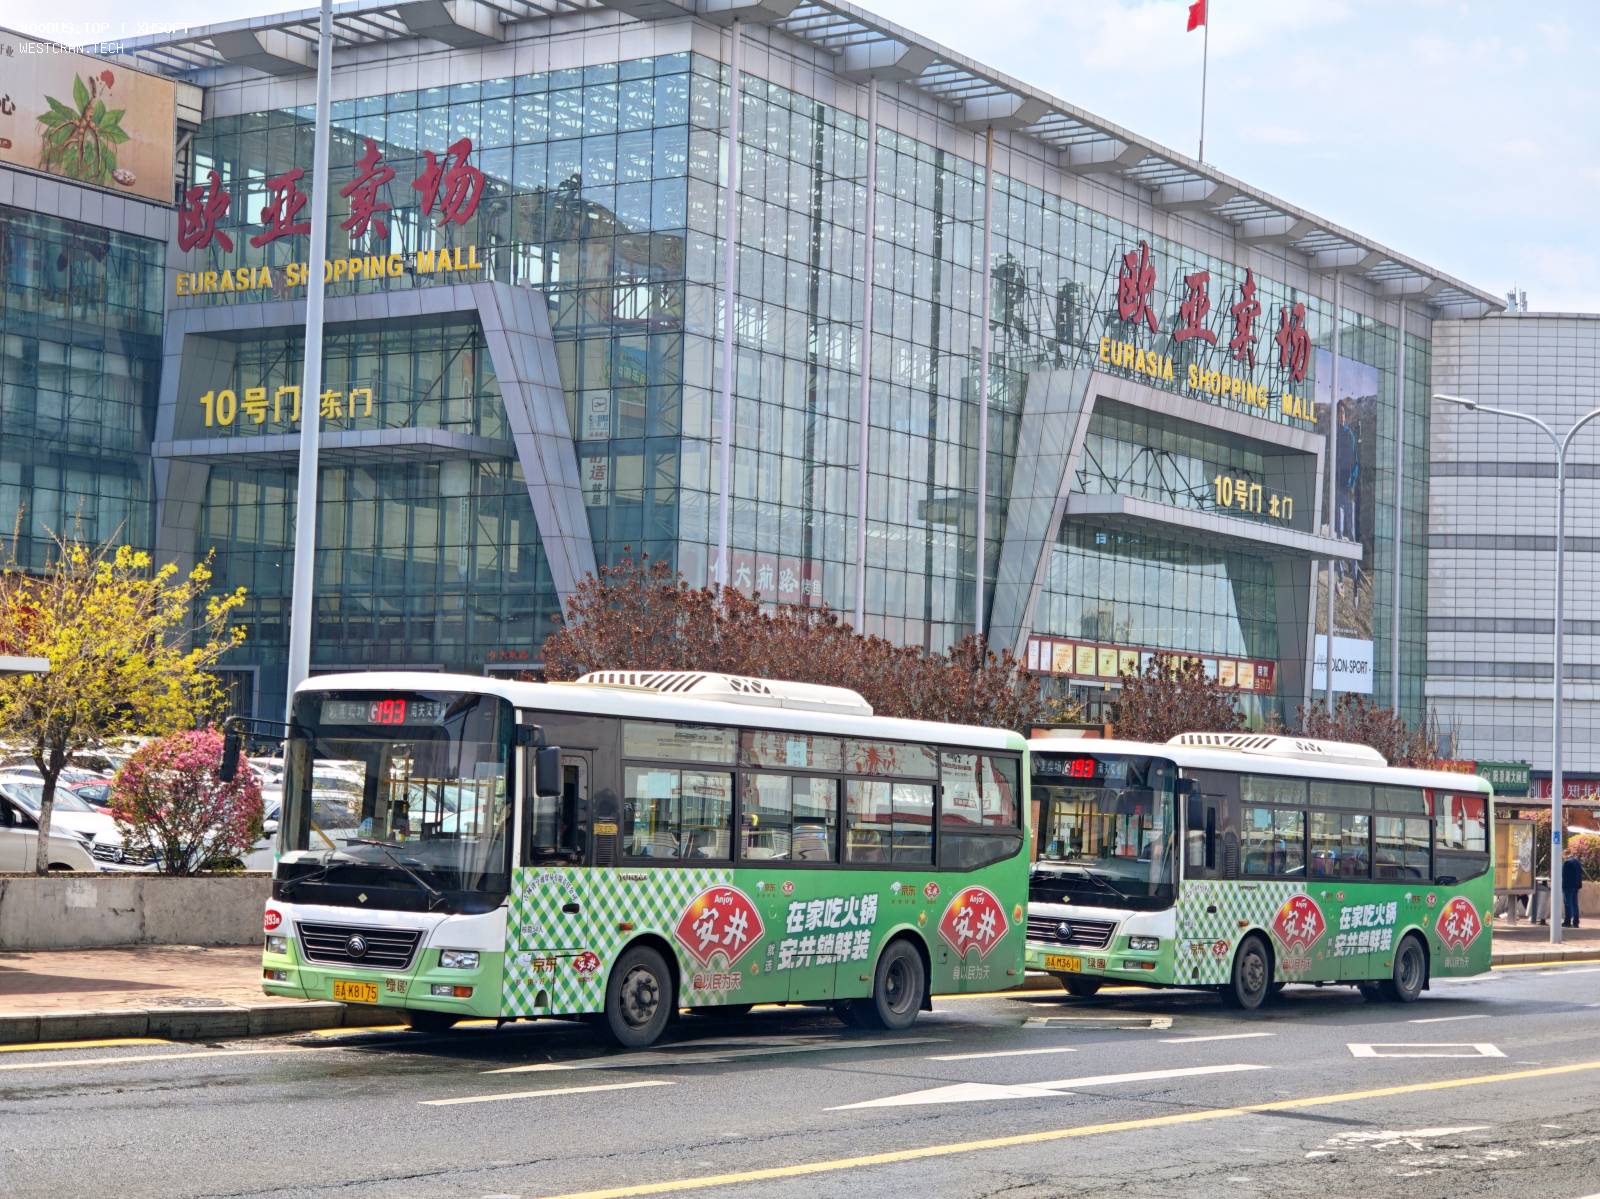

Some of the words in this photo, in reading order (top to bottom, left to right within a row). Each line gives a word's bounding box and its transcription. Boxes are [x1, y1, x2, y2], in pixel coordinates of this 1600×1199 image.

[178, 137, 486, 253] 欧亚卖场
[176, 267, 272, 297] EURASIA
[286, 254, 402, 287] SHOPPING
[416, 245, 482, 275] MALL
[1117, 239, 1313, 383] 欧亚卖场
[1098, 336, 1174, 382] EURASIA
[1187, 364, 1269, 409] SHOPPING
[1281, 393, 1318, 424] MALL
[199, 386, 302, 428] 10号门
[319, 387, 374, 418] 东门
[1214, 474, 1262, 514] 10号门
[714, 894, 733, 905] Anjoy
[786, 893, 879, 934] 在家吃火锅
[970, 893, 985, 904] Anjoy
[1339, 902, 1397, 930] 在家吃火锅
[693, 907, 750, 951] 安井
[953, 905, 996, 945] 安井
[1283, 911, 1317, 940] 安井
[1334, 928, 1393, 957] 安井锁鲜装
[1446, 912, 1473, 941] 安井
[533, 957, 557, 973] 京东
[777, 930, 871, 971] 安井锁鲜装
